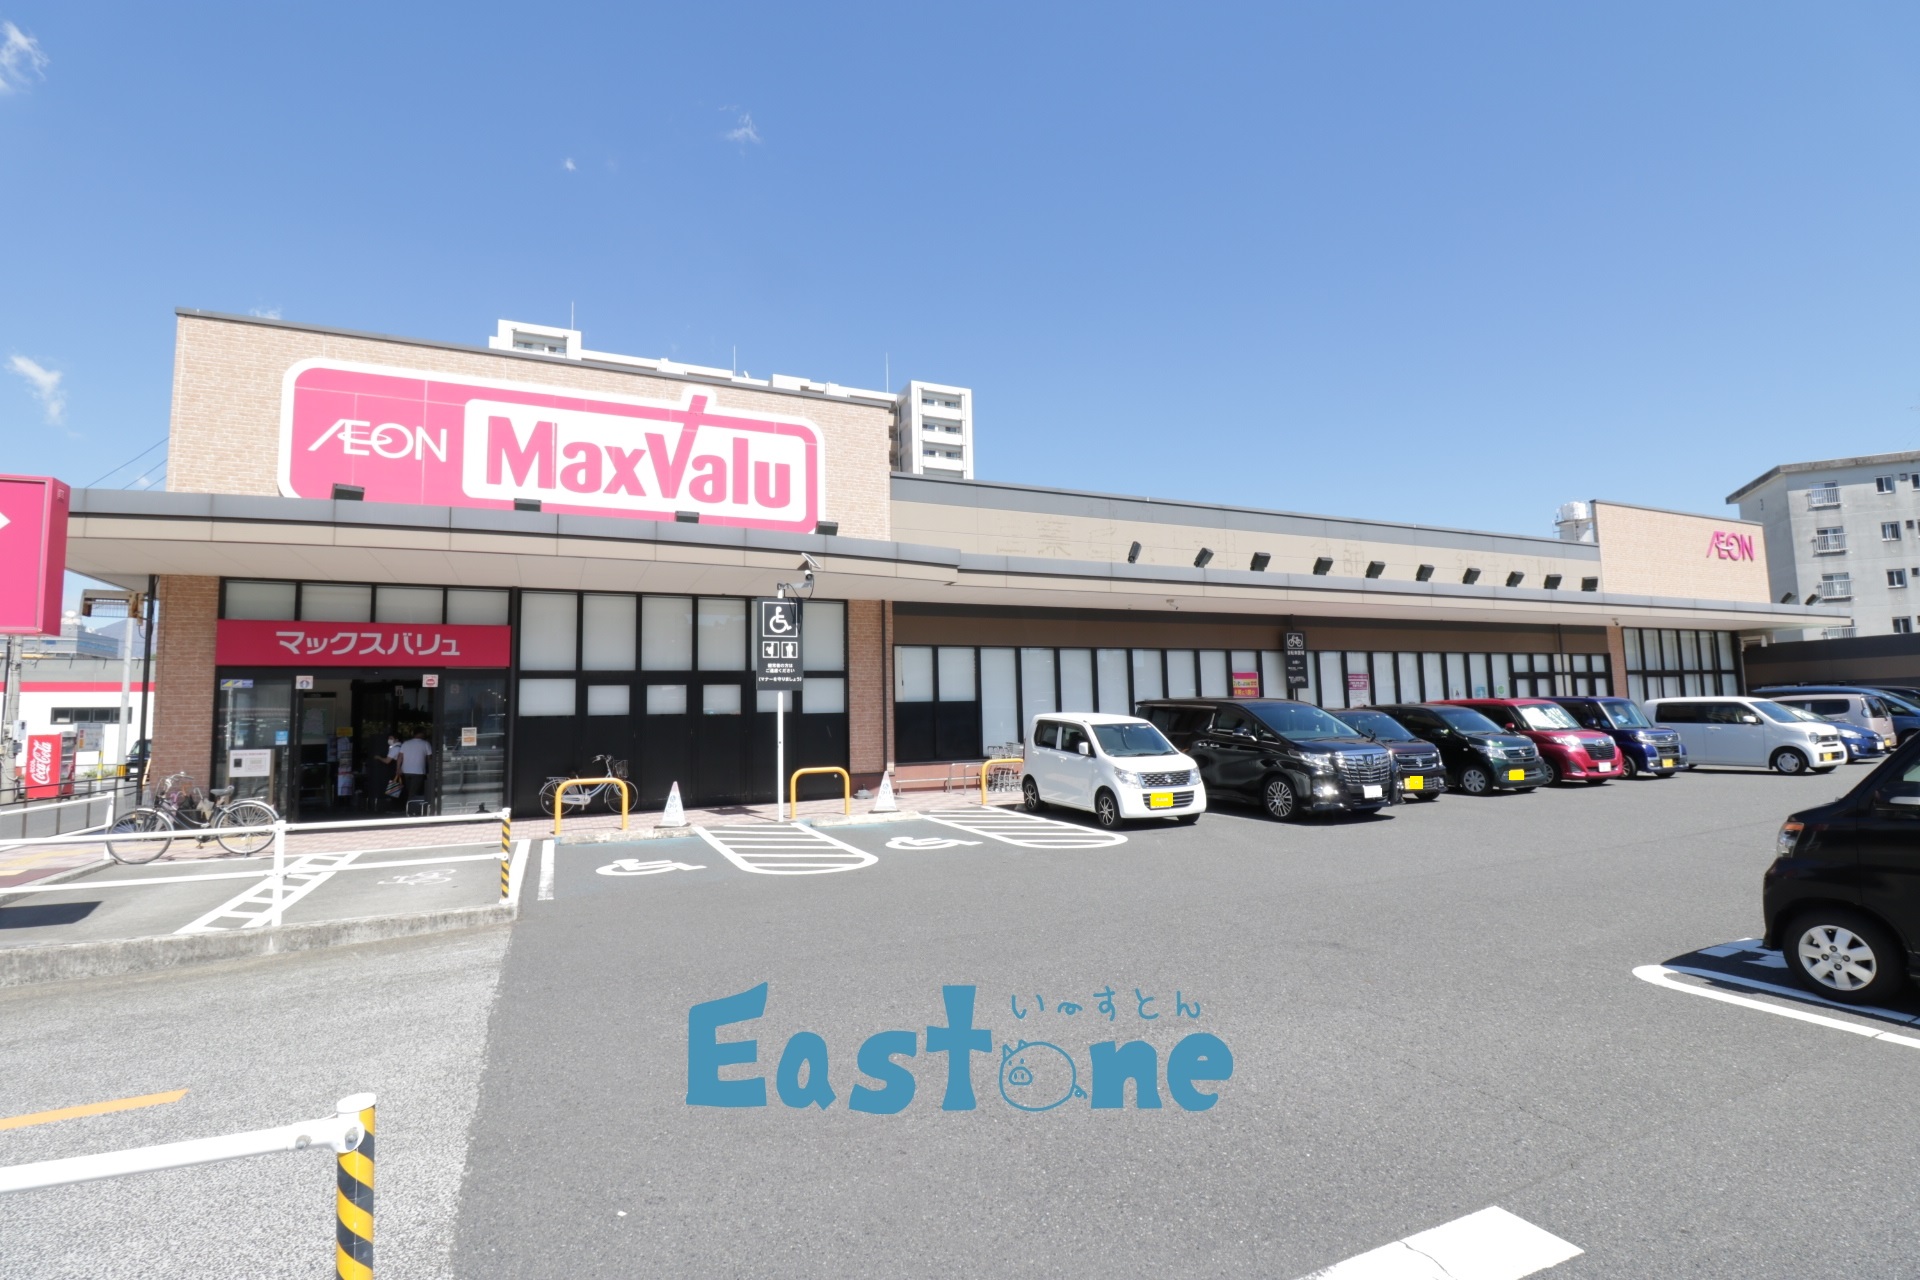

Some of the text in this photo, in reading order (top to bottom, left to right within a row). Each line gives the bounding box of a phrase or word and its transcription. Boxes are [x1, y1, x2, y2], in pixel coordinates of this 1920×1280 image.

[487, 395, 791, 509] MaxValu
[275, 630, 461, 657] マックスバリュ
[32, 740, 52, 784] Coca-Cola
